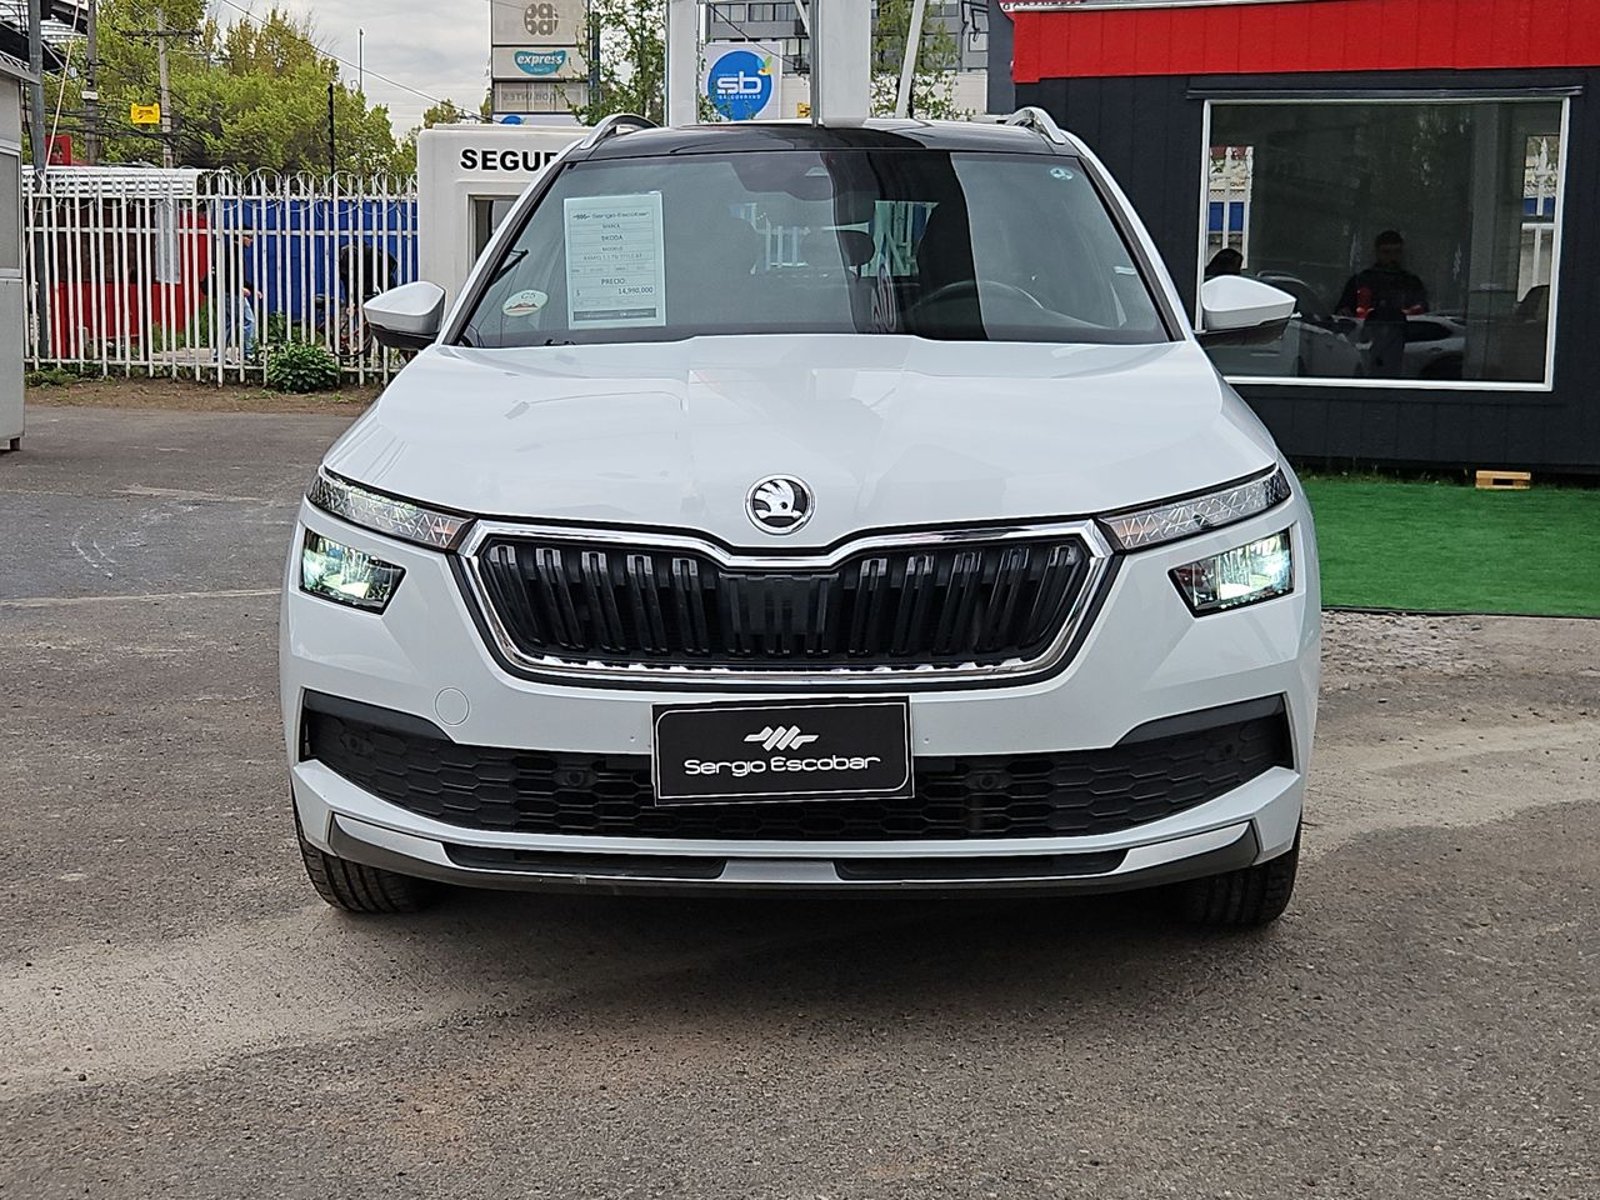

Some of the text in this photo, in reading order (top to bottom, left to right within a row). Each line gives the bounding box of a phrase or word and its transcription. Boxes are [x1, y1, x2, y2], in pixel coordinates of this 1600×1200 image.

[517, 54, 563, 66] express
[717, 71, 762, 94] sb
[684, 755, 881, 777] Sergio Escobar
